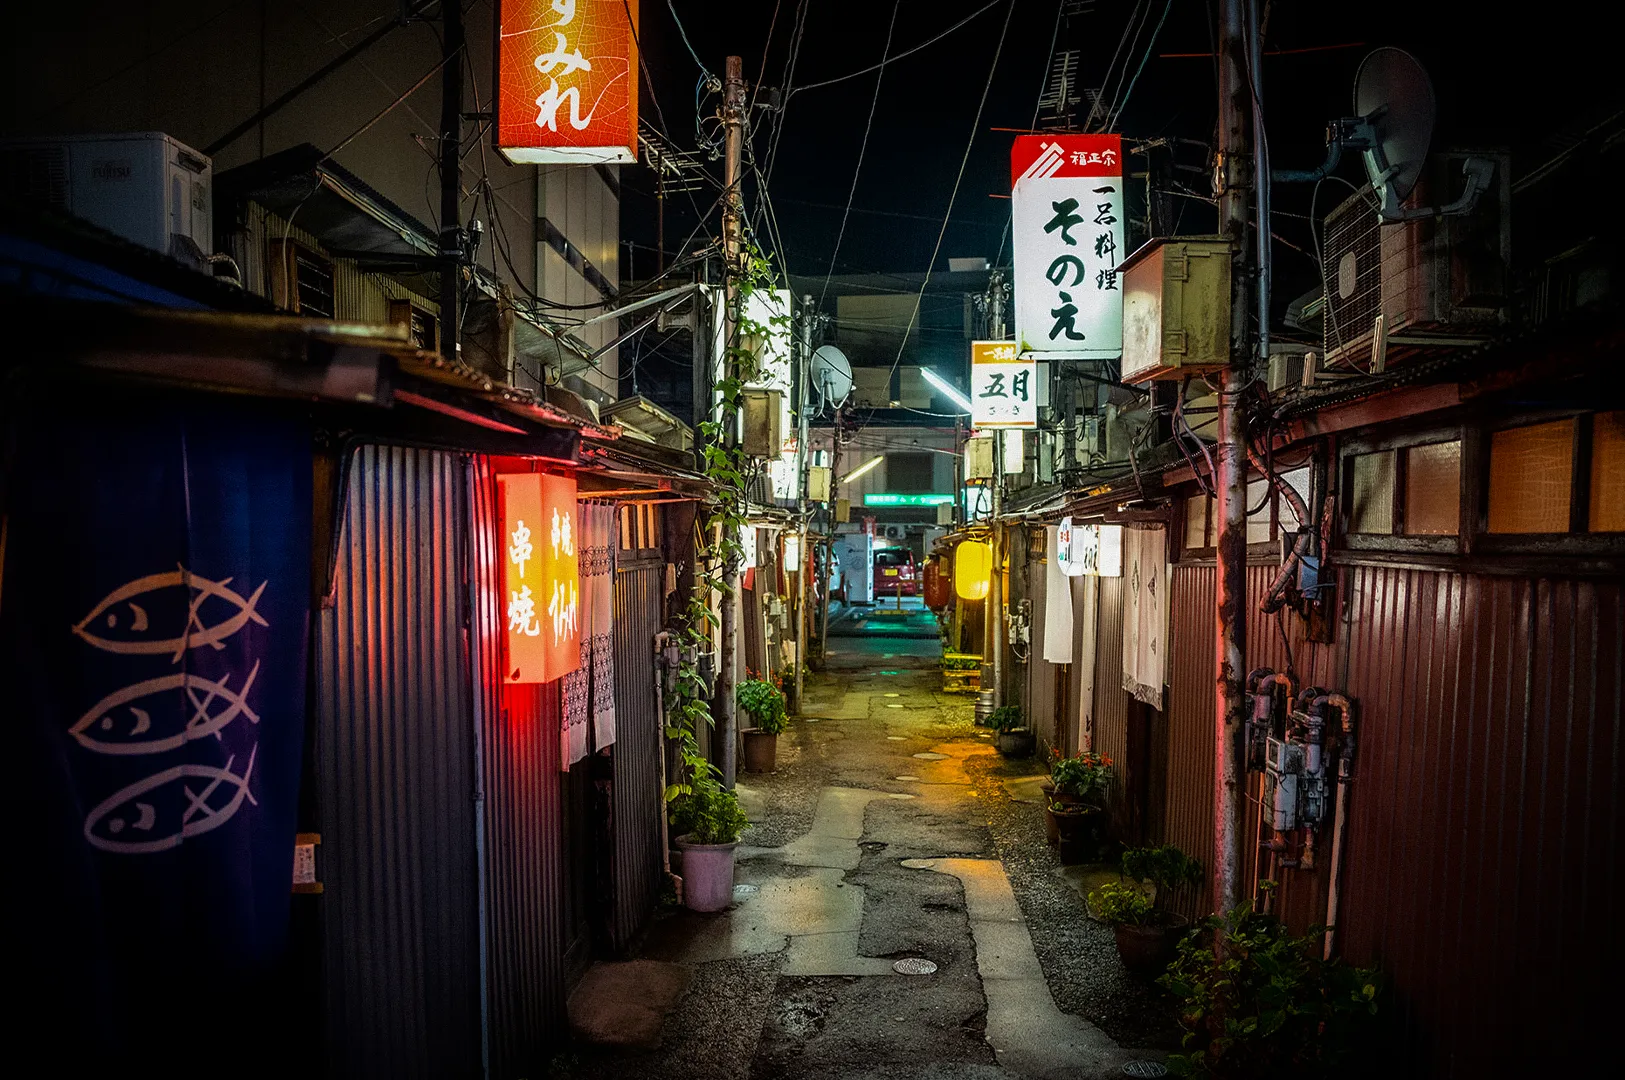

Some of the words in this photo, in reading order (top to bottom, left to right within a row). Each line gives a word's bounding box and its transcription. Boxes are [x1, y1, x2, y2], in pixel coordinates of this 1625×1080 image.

[1070, 149, 1117, 167] 福正宗
[1043, 197, 1086, 341] そのえ
[979, 369, 1030, 402] 五月
